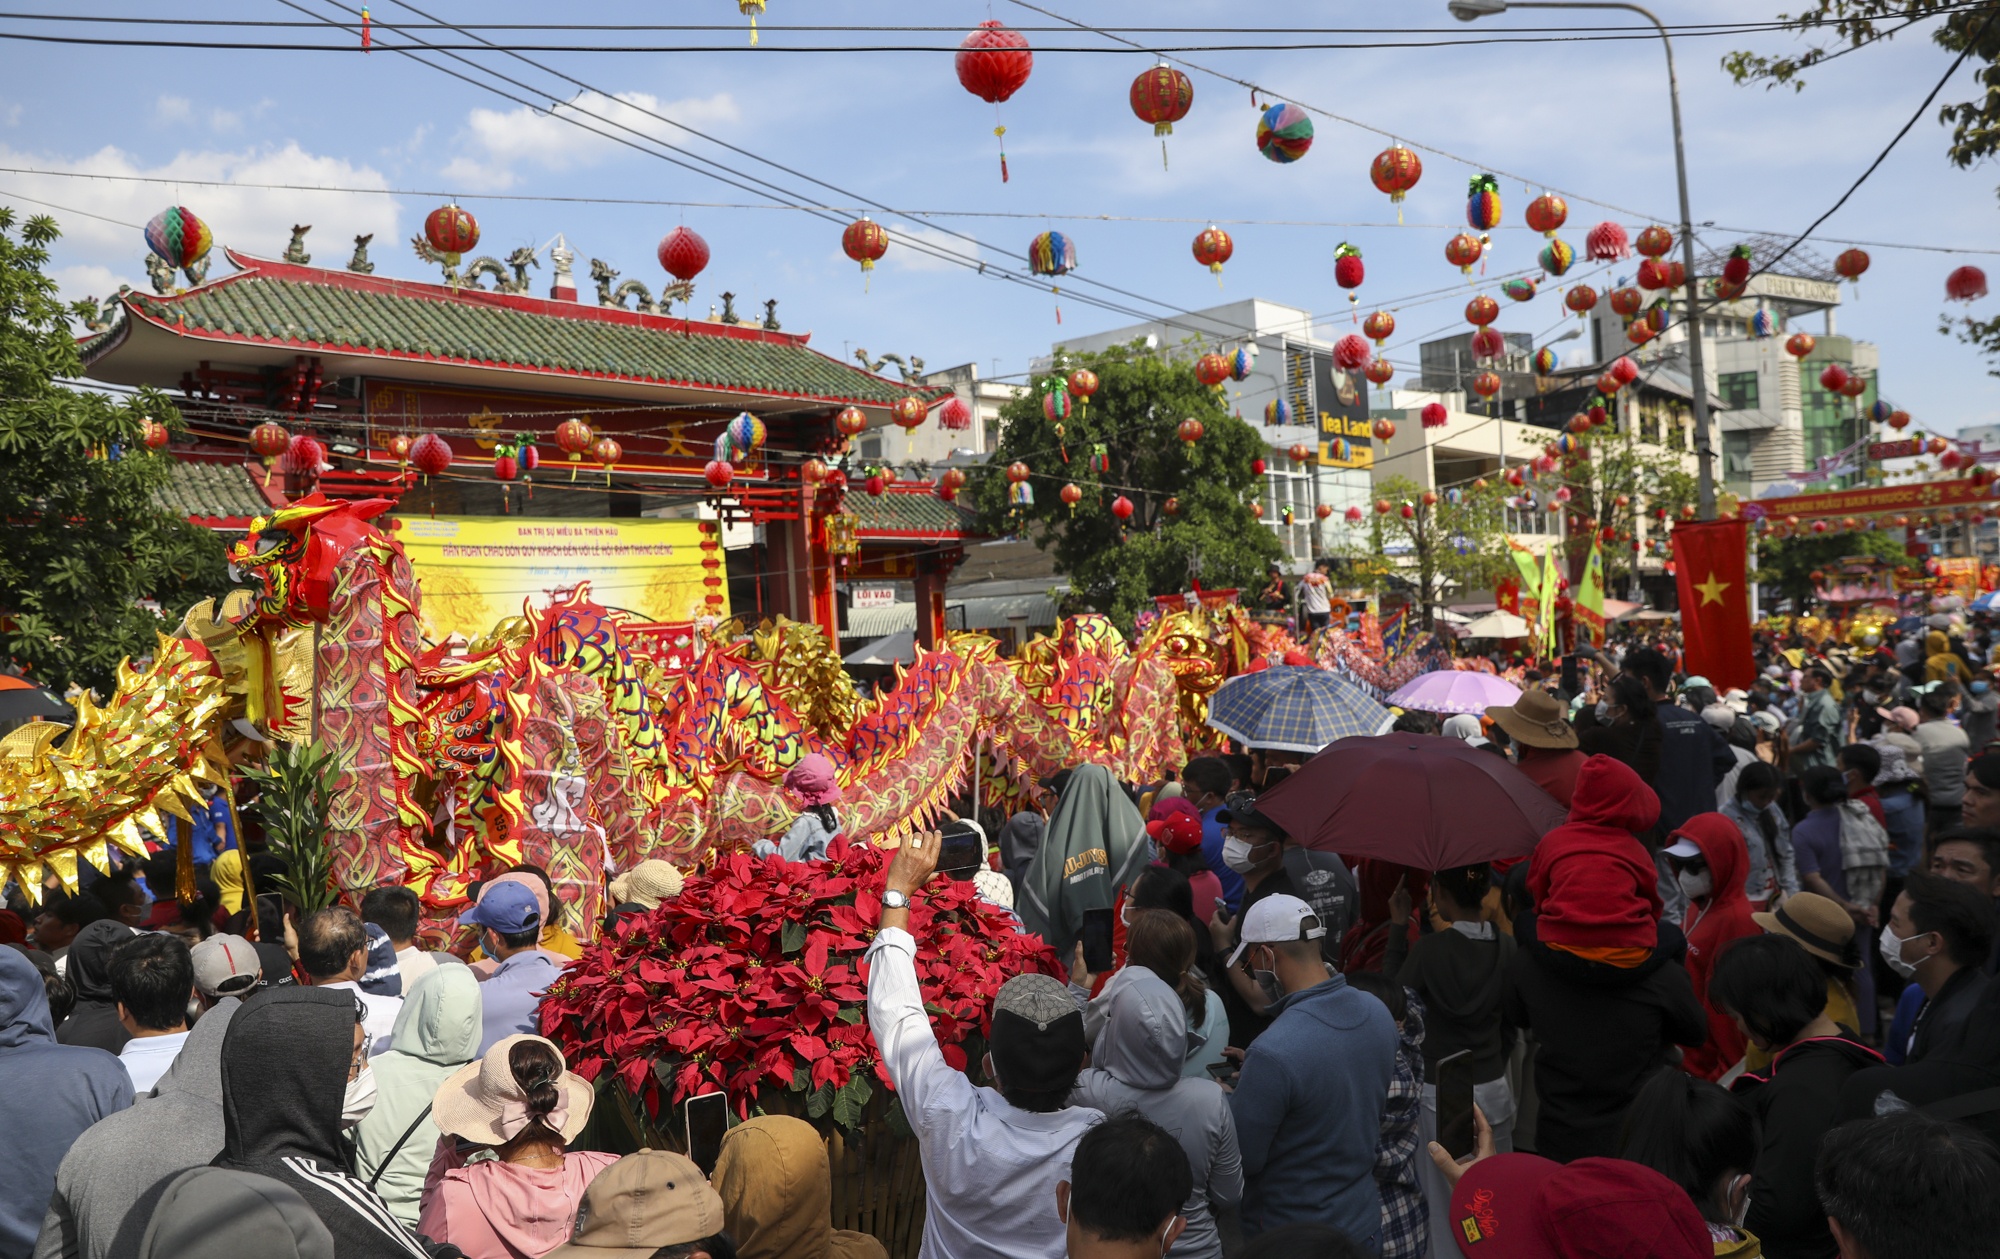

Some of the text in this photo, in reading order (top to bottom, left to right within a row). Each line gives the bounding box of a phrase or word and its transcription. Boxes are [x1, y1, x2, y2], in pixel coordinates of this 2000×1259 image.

[1319, 411, 1372, 438] Tea Land
[518, 528, 531, 536] BAN
[534, 528, 544, 538] TRỊ
[585, 526, 603, 536] THIÊN
[857, 587, 891, 599] LỐI VÀO
